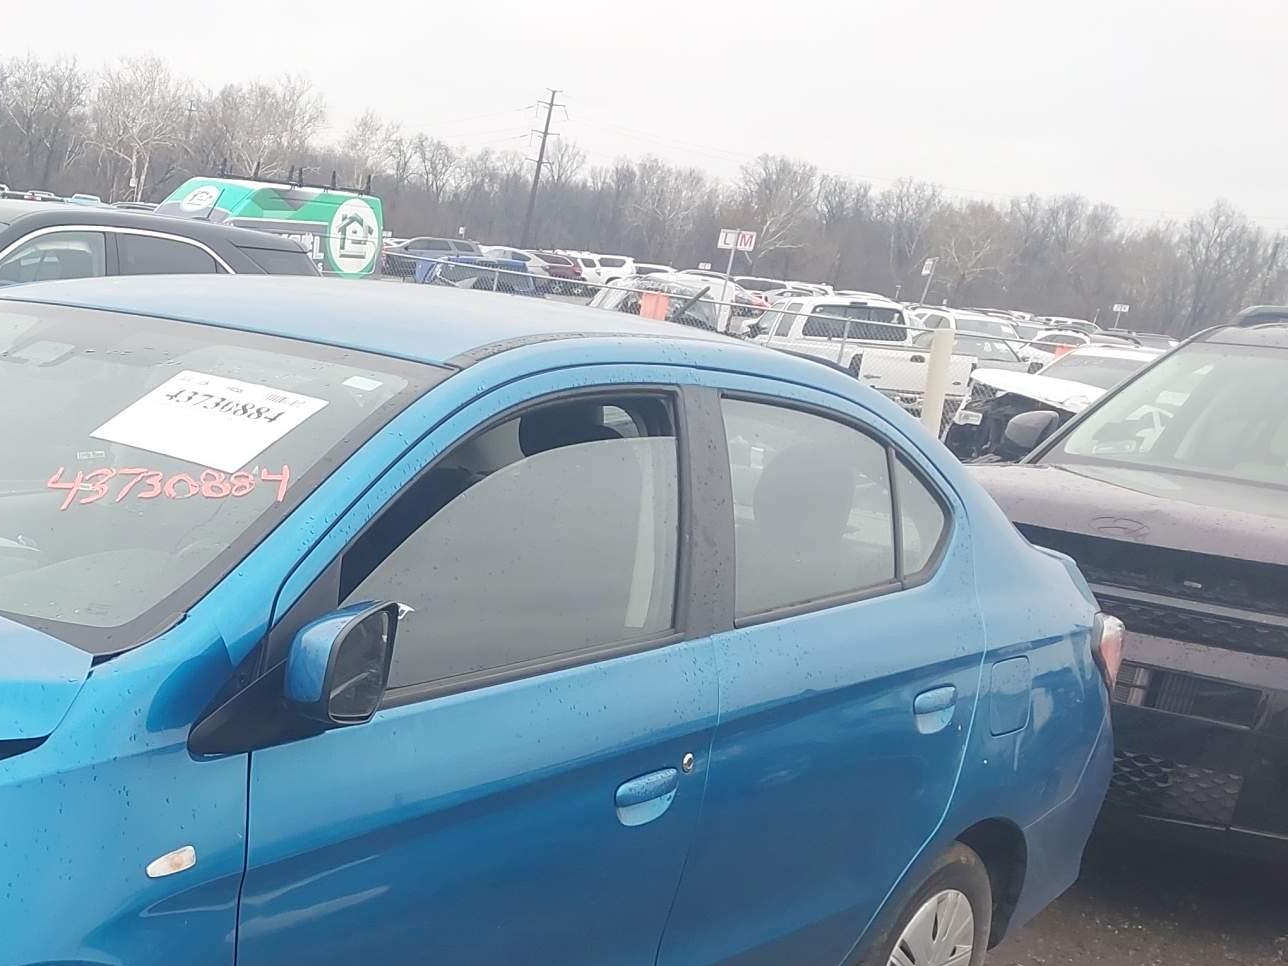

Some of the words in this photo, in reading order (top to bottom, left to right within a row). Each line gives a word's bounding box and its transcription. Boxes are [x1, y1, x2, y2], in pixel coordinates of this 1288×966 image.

[739, 233, 754, 248] M
[165, 388, 287, 423] 43730884
[47, 464, 290, 511] 43730884
